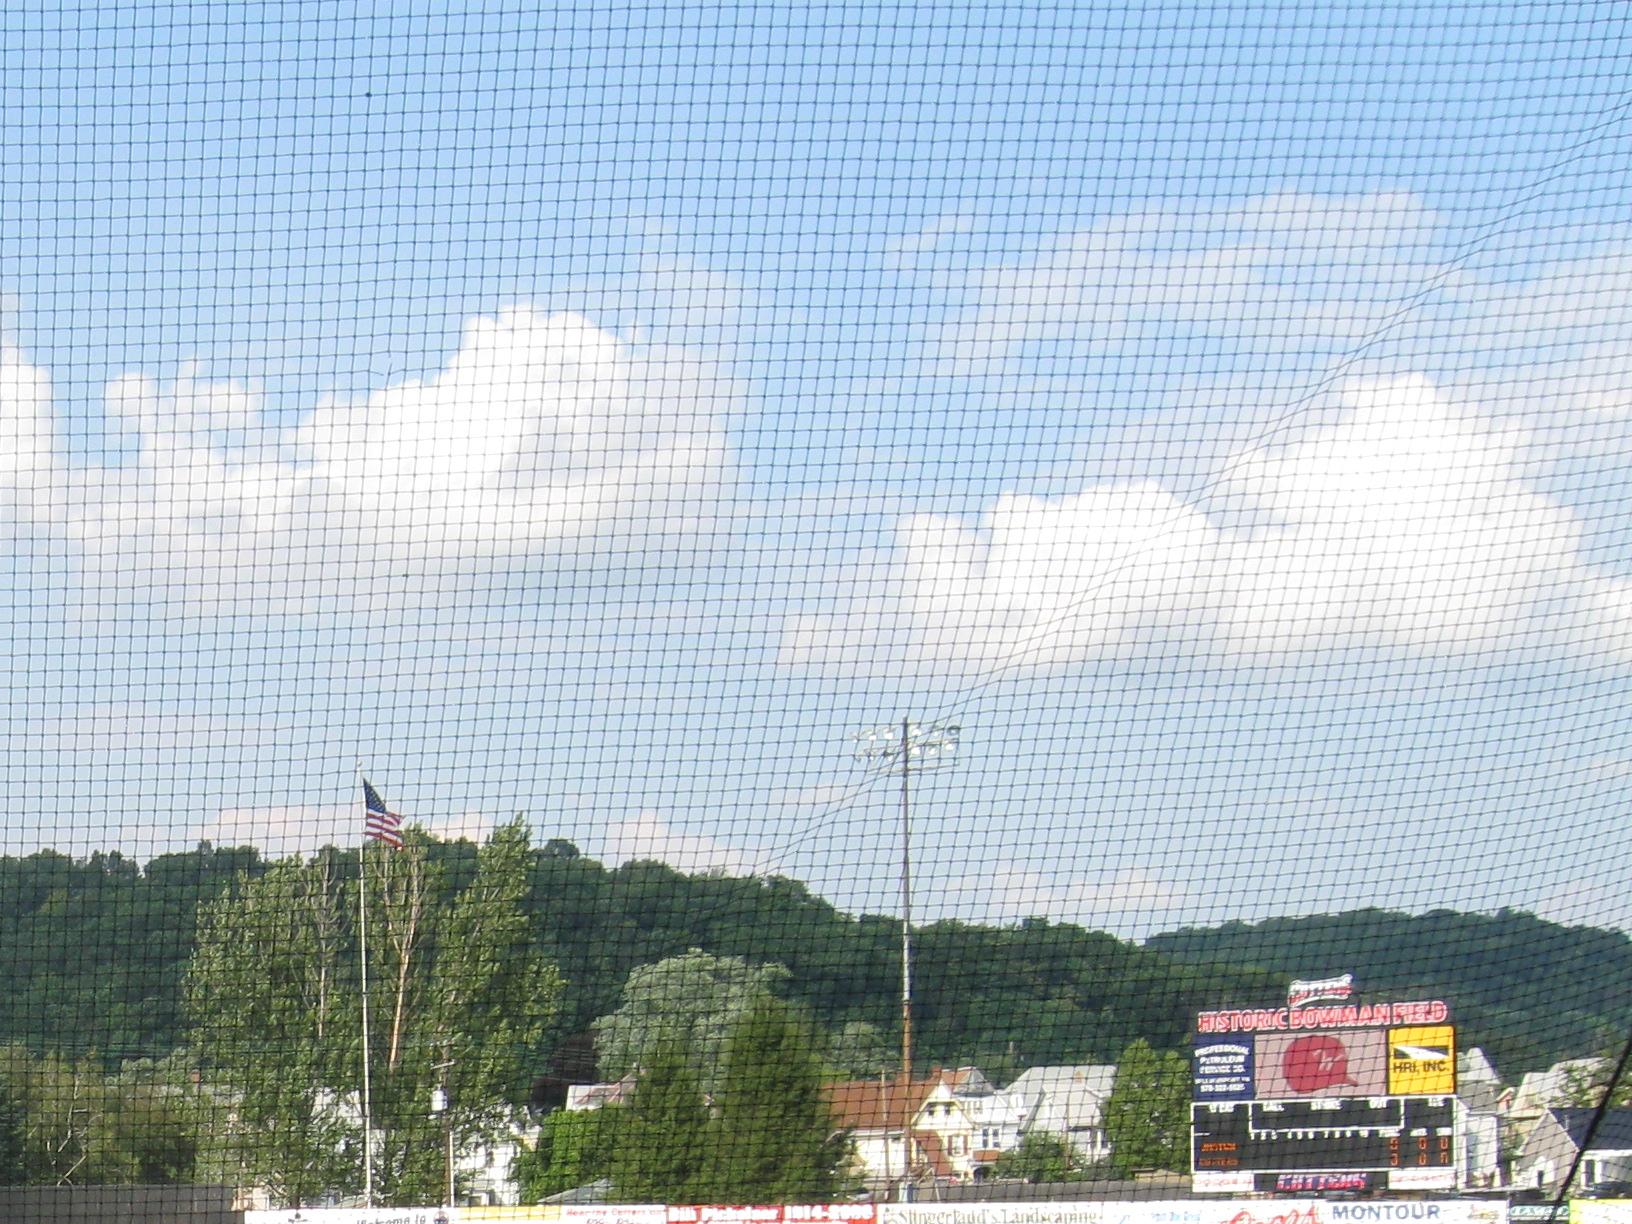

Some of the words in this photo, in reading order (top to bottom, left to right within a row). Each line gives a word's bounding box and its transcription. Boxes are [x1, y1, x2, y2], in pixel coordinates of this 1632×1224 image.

[1198, 1009, 1288, 1032] HISTORIC
[1289, 1004, 1390, 1029] BOWMAN
[1392, 1001, 1447, 1023] FIELD
[1423, 1060, 1449, 1072] INC.
[1332, 1204, 1440, 1220] MONTOUR
